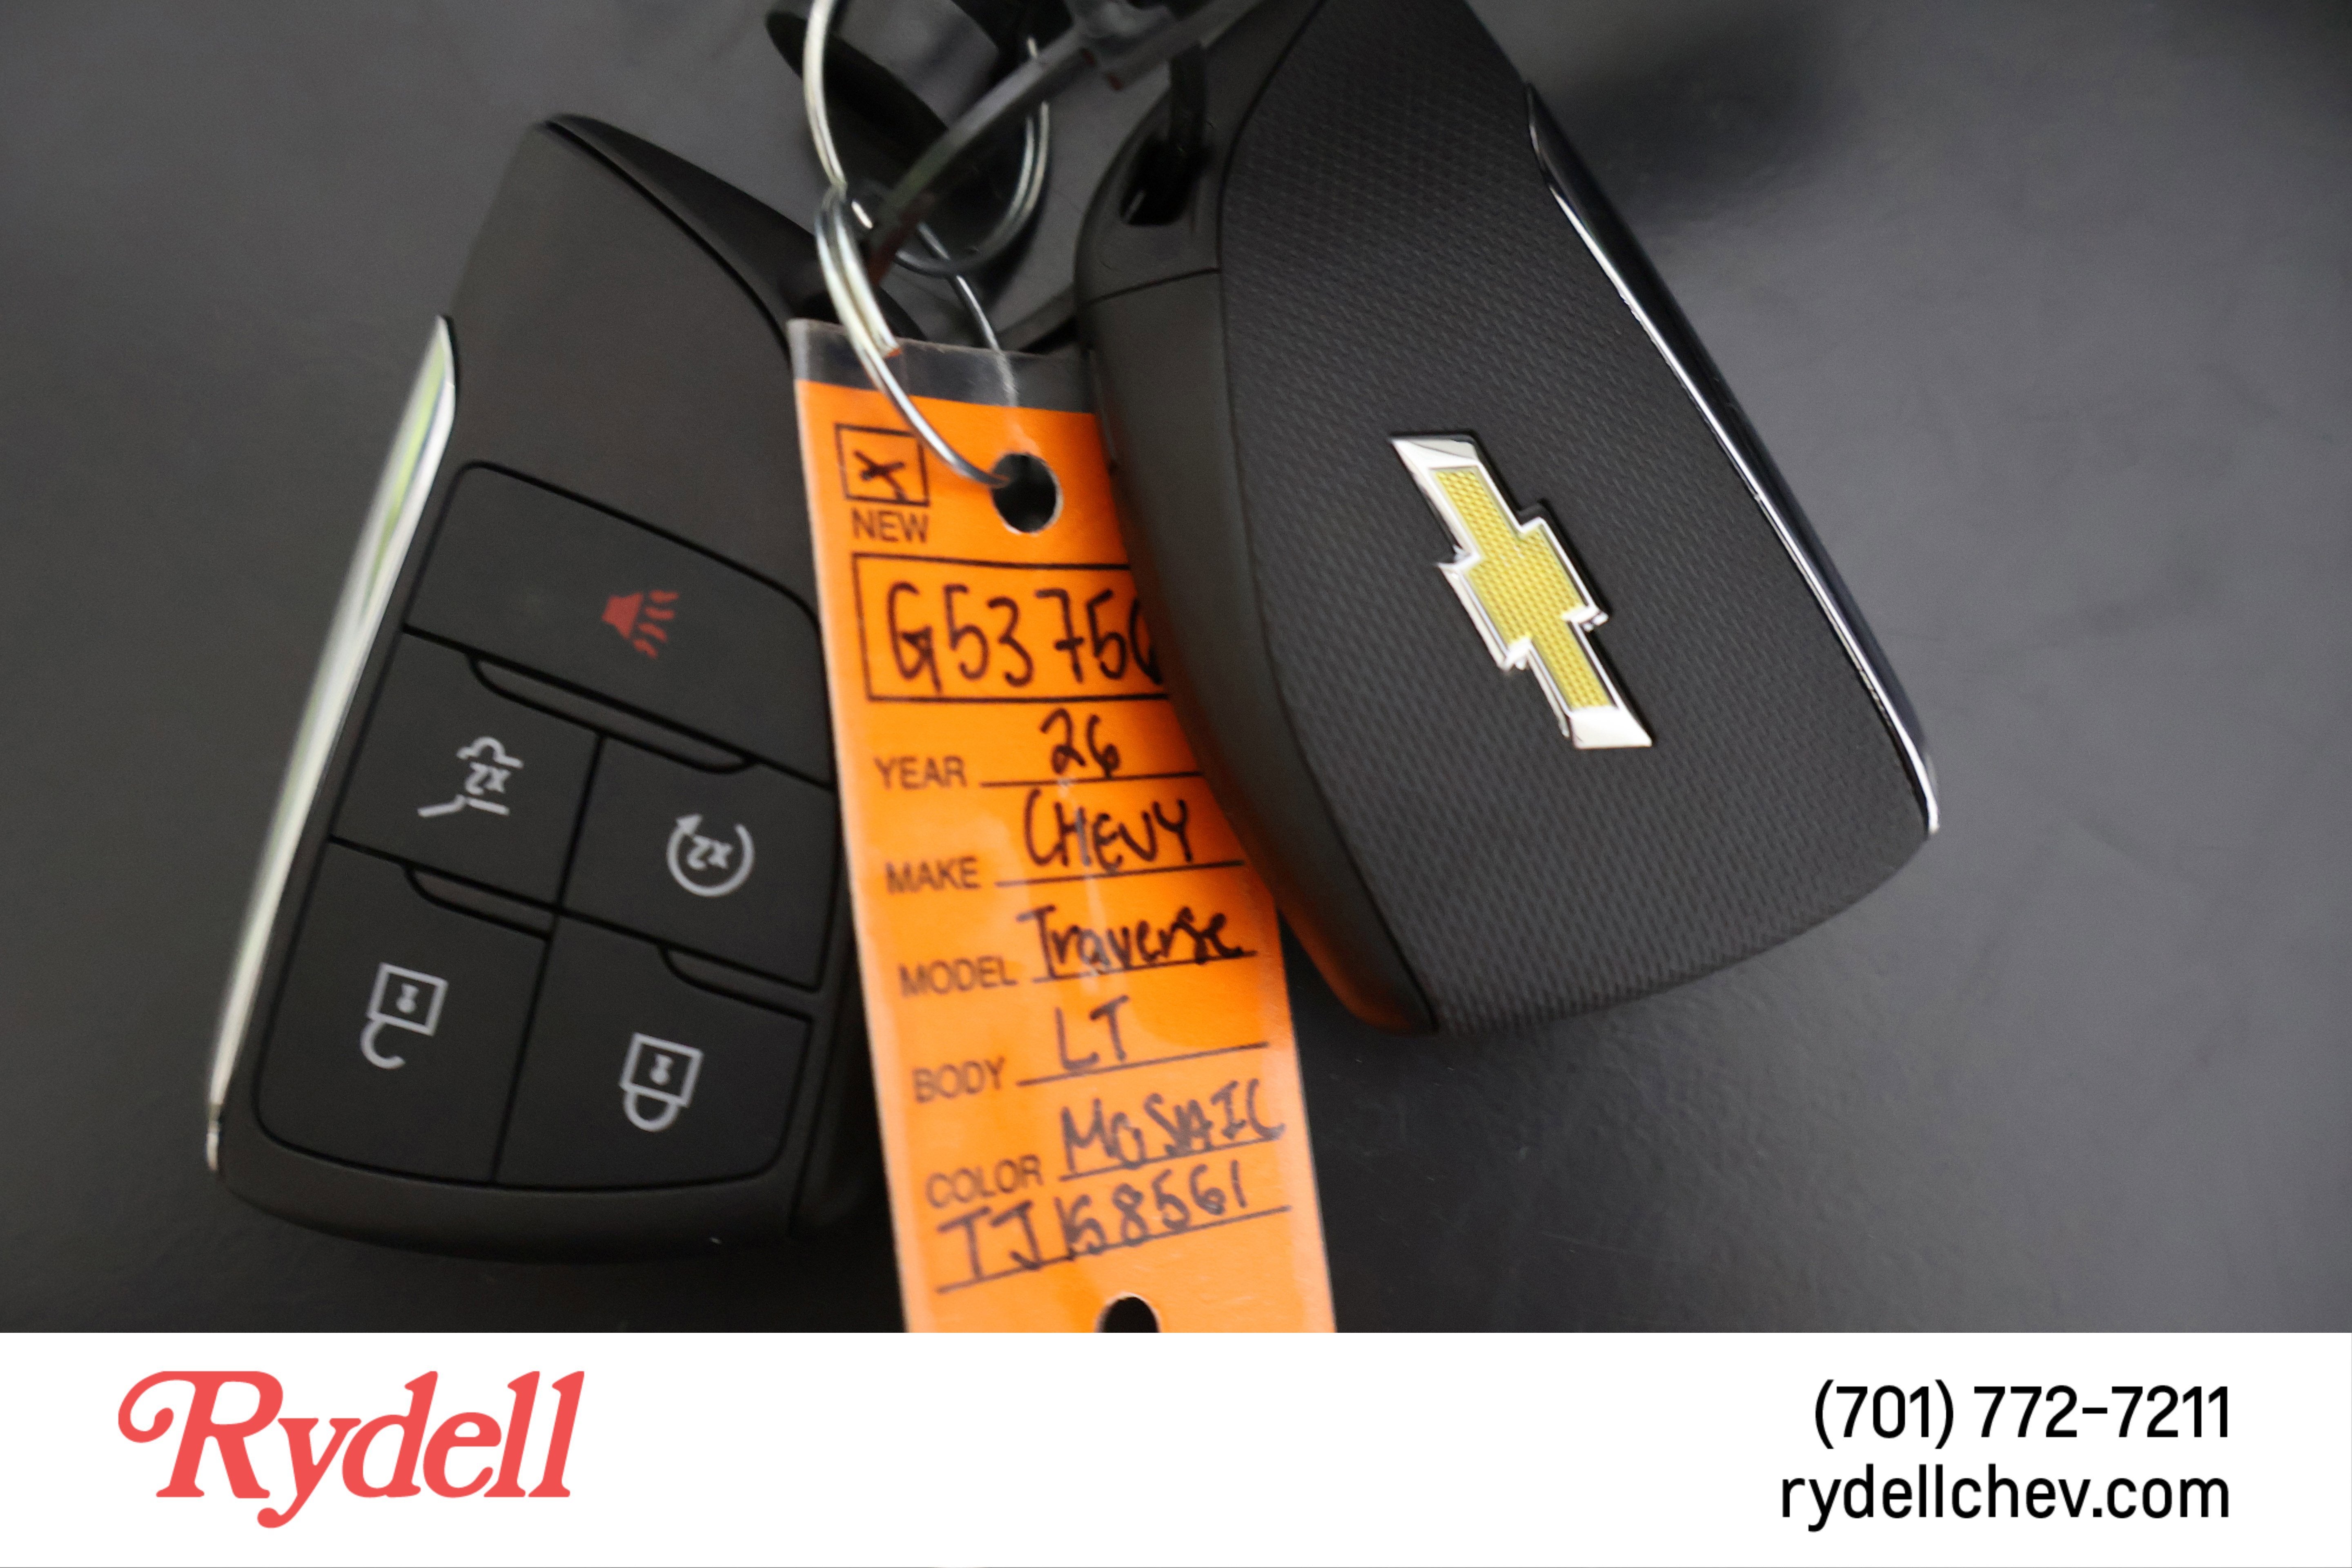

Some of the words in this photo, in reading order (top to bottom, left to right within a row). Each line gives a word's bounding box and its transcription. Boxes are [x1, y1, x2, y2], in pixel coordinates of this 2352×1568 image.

[851, 508, 929, 542] NEW
[873, 756, 967, 790] YEAR
[1039, 707, 1121, 778] 26
[885, 855, 980, 894] MAKE
[1023, 788, 1192, 872] CHEVY
[899, 956, 1018, 997] MODEL
[1016, 904, 1245, 980] Traverse
[912, 1057, 1006, 1104] BODY
[1055, 995, 1129, 1071] LT
[925, 1154, 1044, 1209] COLOR
[1061, 1078, 1286, 1173] MOSAIC
